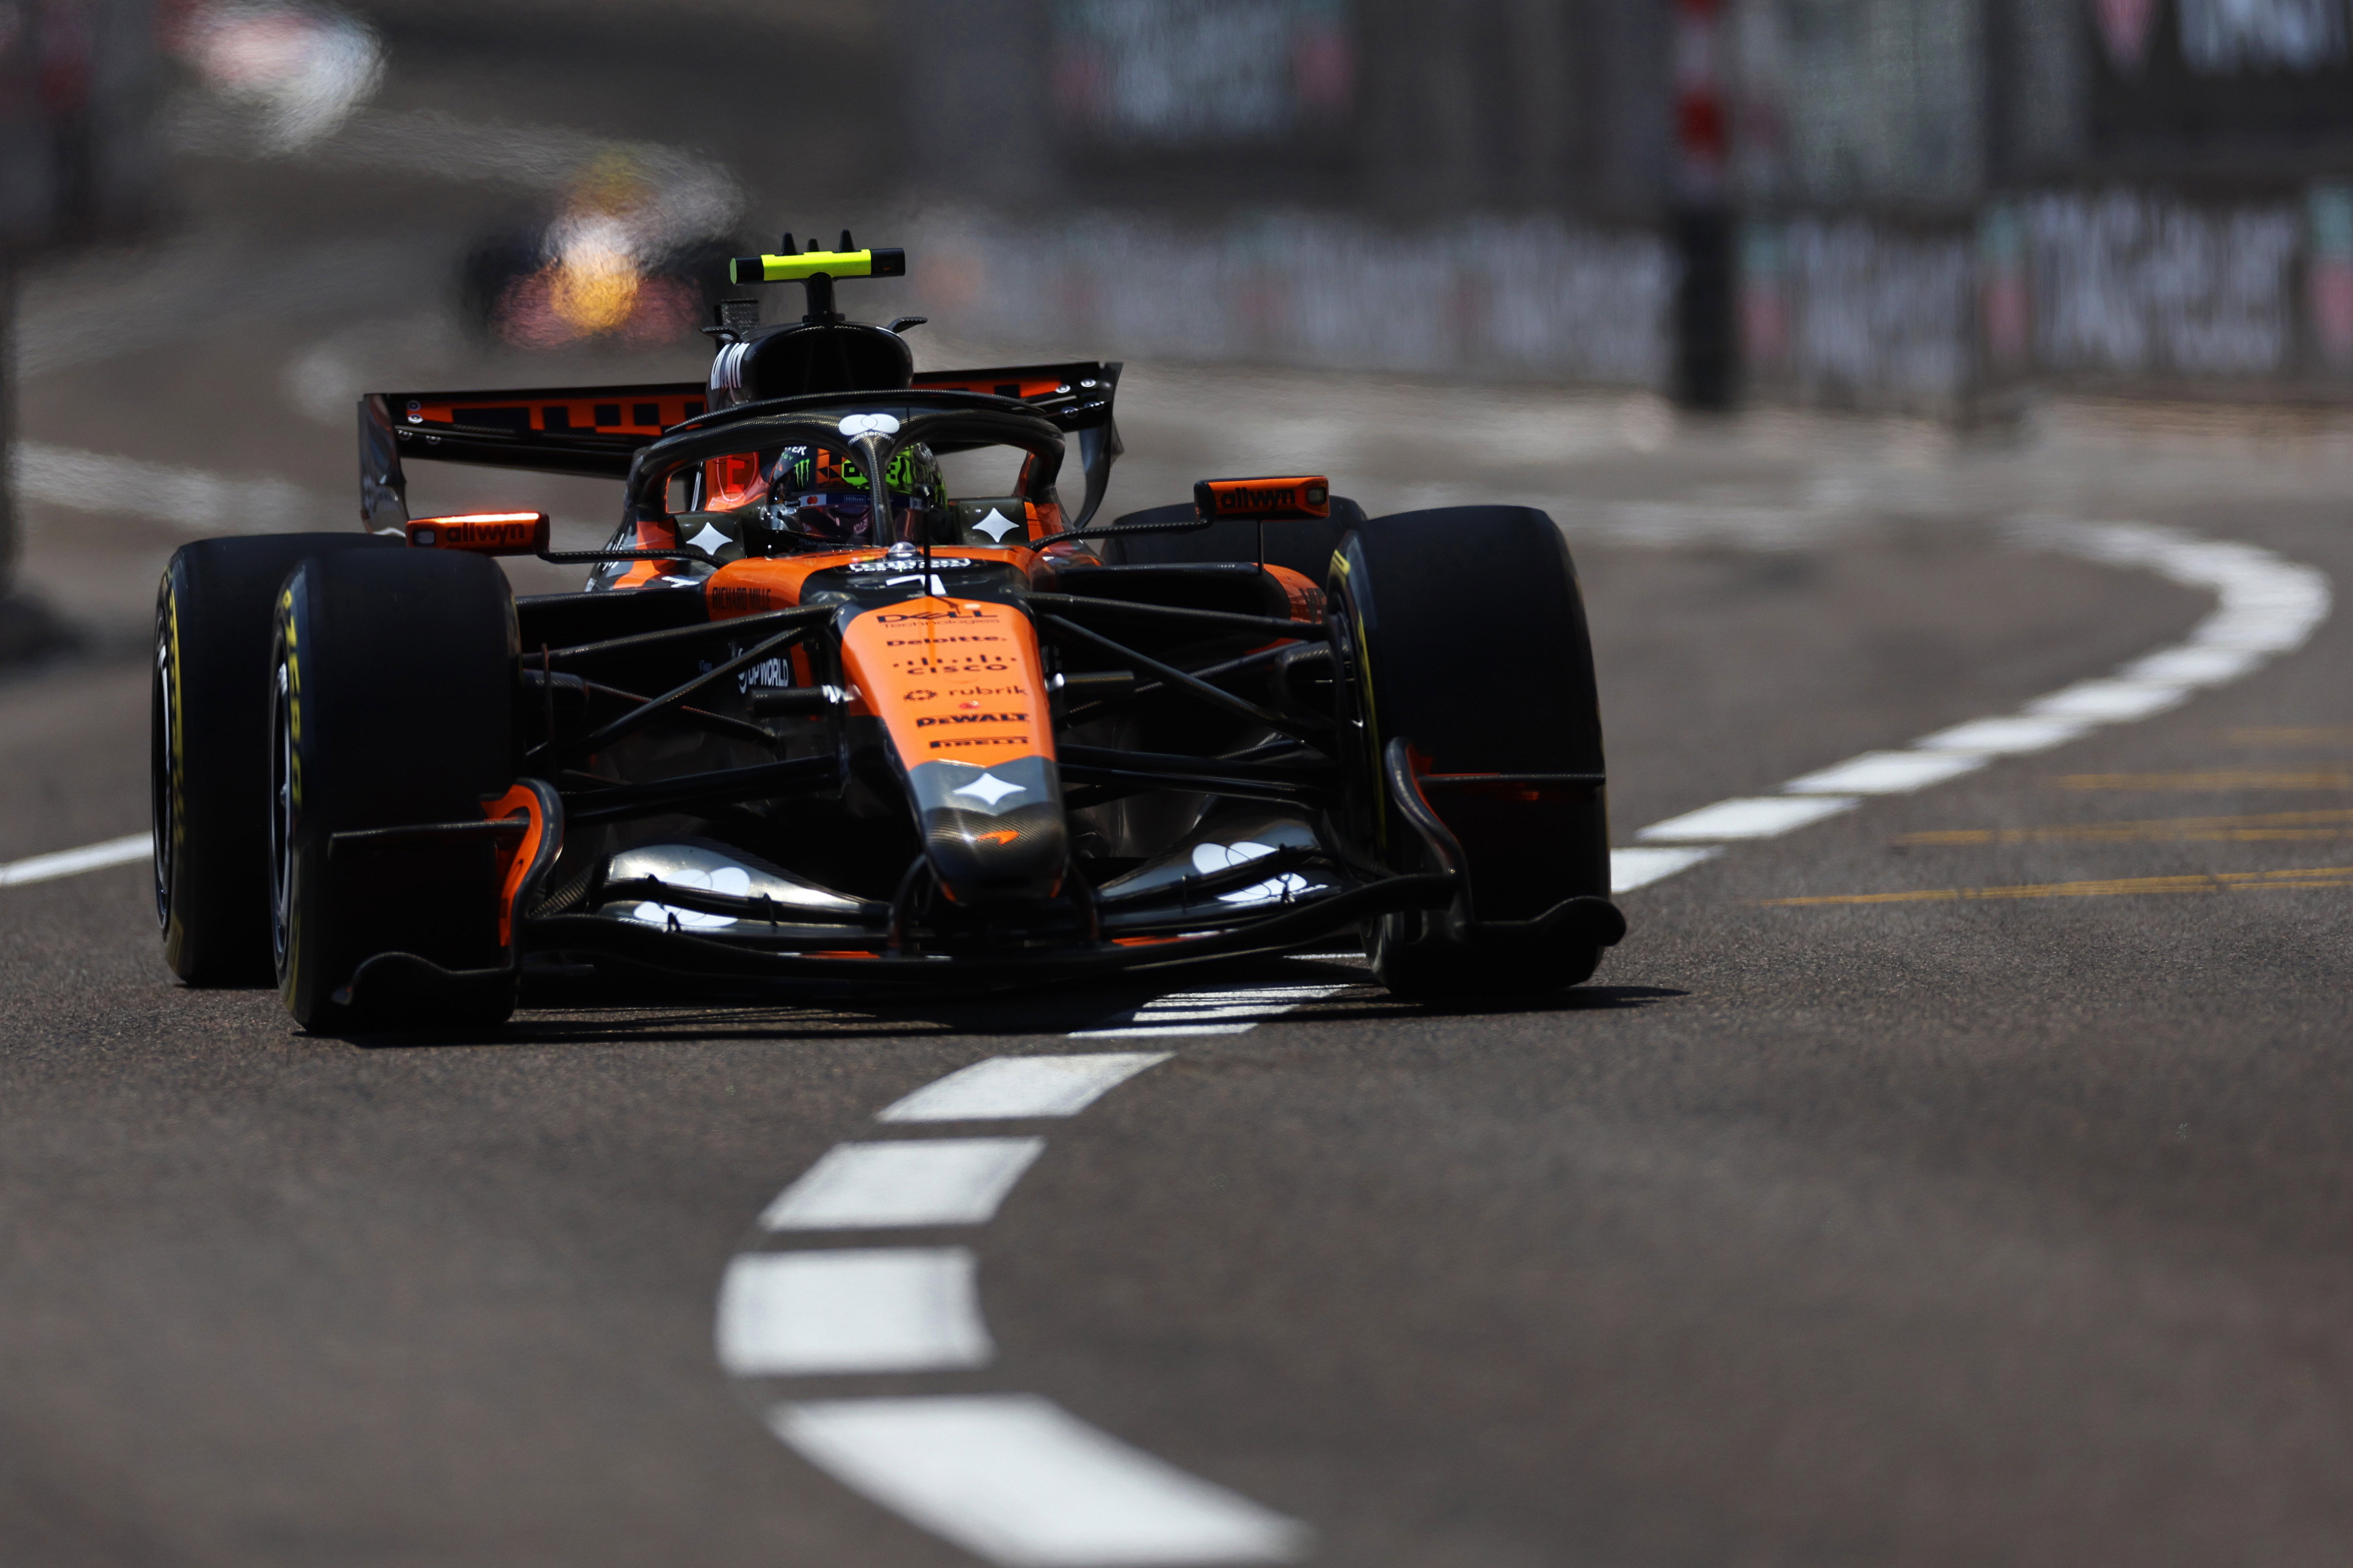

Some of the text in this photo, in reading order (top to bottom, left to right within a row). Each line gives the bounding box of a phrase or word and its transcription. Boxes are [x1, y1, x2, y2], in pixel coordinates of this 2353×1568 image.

[1221, 487, 1296, 510] allwyn
[446, 522, 525, 545] allwyn
[877, 610, 999, 623] DELL
[885, 619, 1000, 628] Technologies
[760, 657, 789, 687] WORLD
[948, 685, 1027, 696] rubrik
